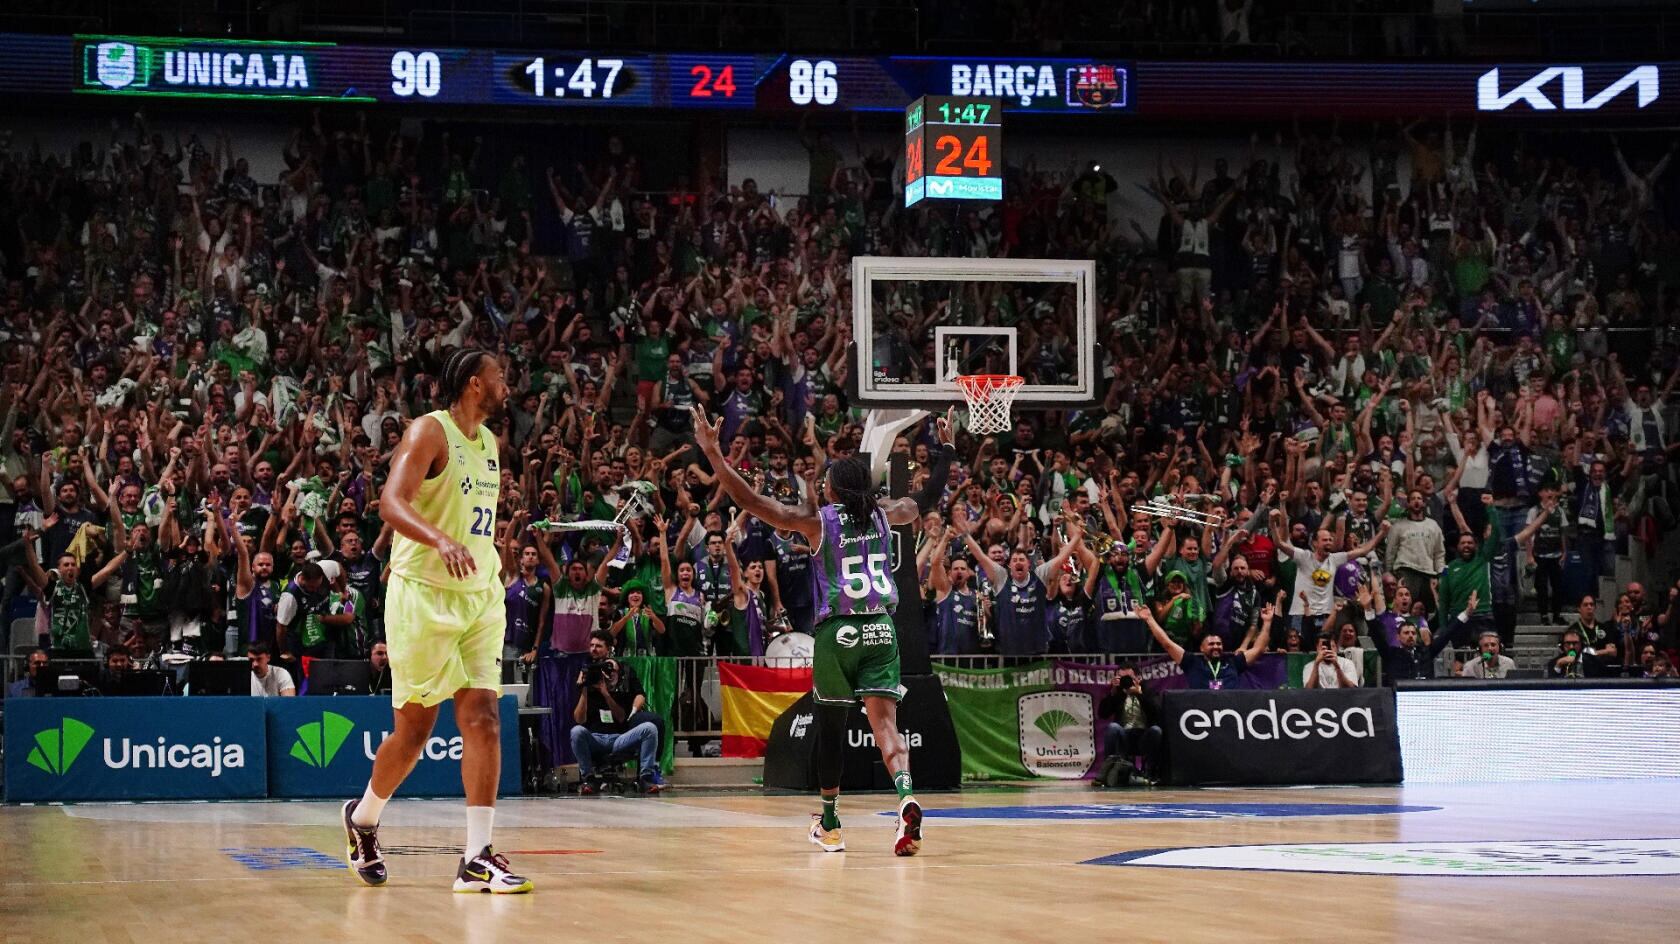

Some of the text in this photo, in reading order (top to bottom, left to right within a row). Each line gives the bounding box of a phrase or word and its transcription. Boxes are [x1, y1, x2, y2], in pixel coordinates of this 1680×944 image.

[164, 51, 309, 89] UNICAJA
[391, 51, 442, 97] 90
[525, 57, 624, 98] 1:47
[690, 65, 737, 98] 24
[789, 59, 838, 105] 86
[951, 64, 1058, 106] BARÇA
[938, 102, 992, 125] 1:47
[935, 134, 993, 176] 24
[470, 506, 493, 537] 22
[841, 553, 892, 600] 55
[862, 623, 892, 632] COSTA
[862, 630, 893, 639] DEL SOL
[1011, 667, 1067, 688] TEMPLO
[1068, 669, 1095, 684] DEL
[1179, 699, 1375, 741] endesa
[105, 736, 246, 777] Unicaja
[848, 729, 922, 751] Unja
[1036, 744, 1080, 758] Unicaja
